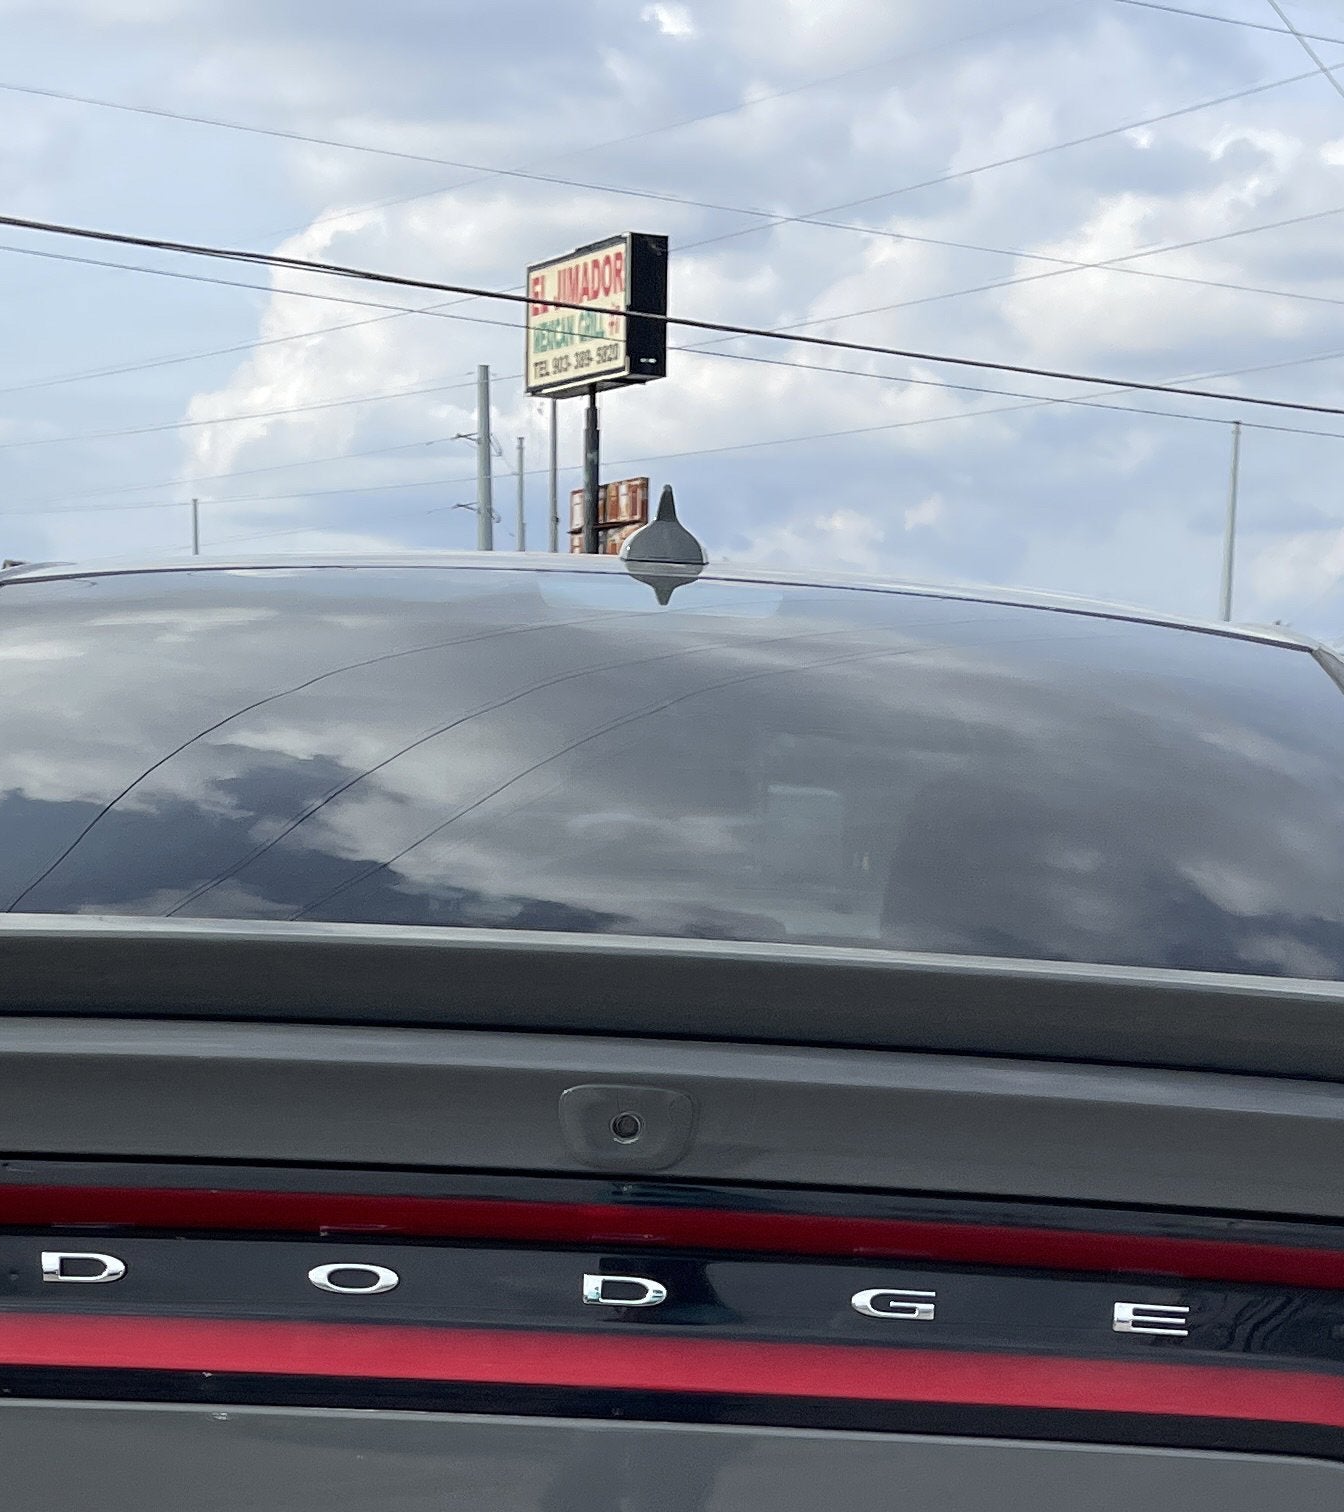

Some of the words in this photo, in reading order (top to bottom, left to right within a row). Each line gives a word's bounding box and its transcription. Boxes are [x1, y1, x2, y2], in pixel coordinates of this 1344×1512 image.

[532, 275, 549, 316] EL
[553, 252, 624, 310] JIMADOR
[42, 1251, 1190, 1336] DODGE
